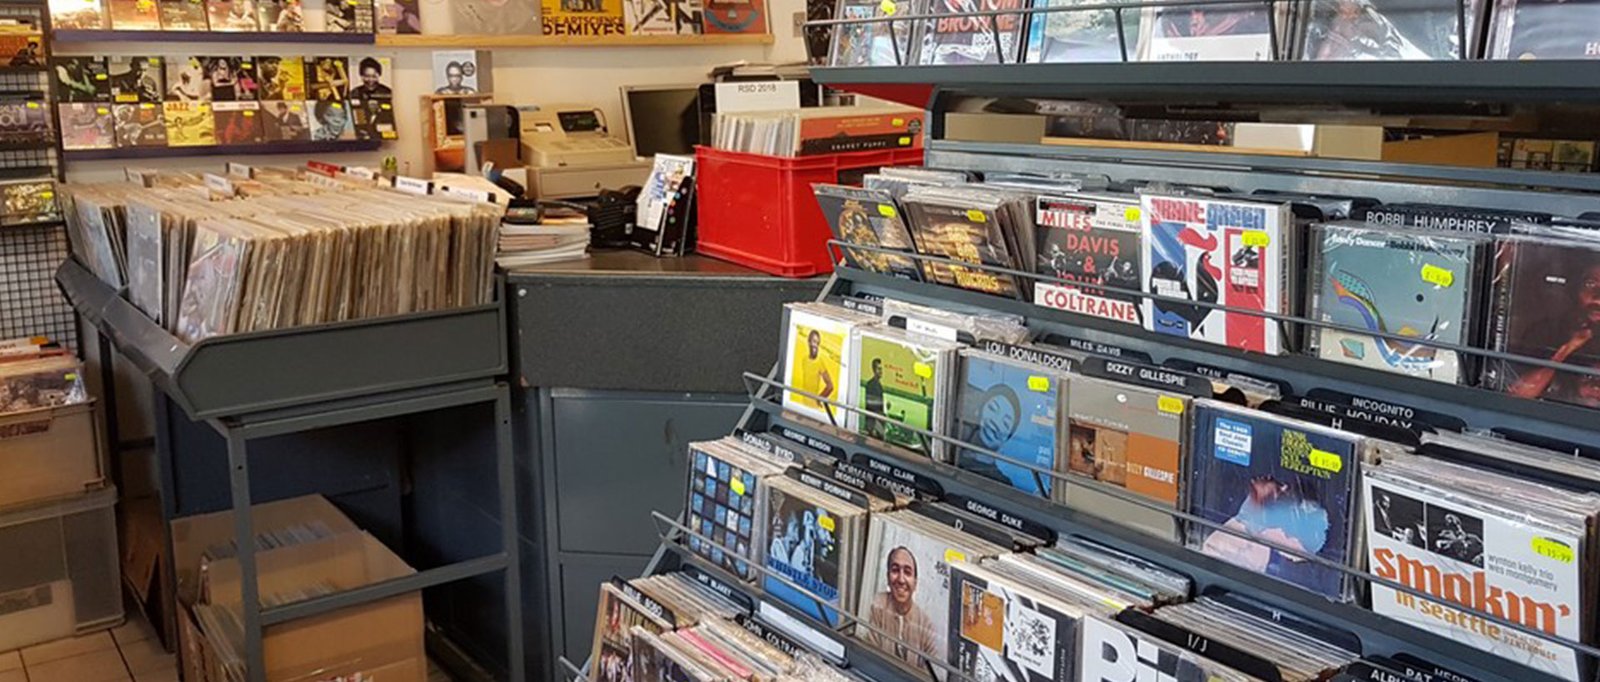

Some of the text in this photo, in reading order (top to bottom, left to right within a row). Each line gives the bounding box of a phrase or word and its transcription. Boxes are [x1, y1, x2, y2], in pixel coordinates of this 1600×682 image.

[738, 84, 776, 93] RSD 2018
[1041, 210, 1092, 233] MILES
[1366, 211, 1405, 226] BOBBI
[1414, 214, 1496, 234] HUMPHREY
[1067, 234, 1119, 256] DAVIS
[1083, 256, 1096, 272] &
[1044, 290, 1136, 321] COLTRANE
[985, 341, 1072, 374] LOU DONALDSON
[1069, 339, 1121, 357] MILES DAVIS
[1106, 362, 1187, 387] DIZZY GILLESPIE
[1352, 397, 1414, 419] INCOGNITO
[1331, 417, 1342, 430] H
[783, 429, 832, 453] GEORGE BENSON
[834, 470, 866, 489] DEODATO
[955, 519, 963, 532] D
[967, 500, 1023, 530] GEORGE DUKE
[813, 578, 838, 598] STOP
[1488, 564, 1557, 592] wes montgomery
[743, 618, 763, 636] JOHN
[1420, 600, 1501, 640] seattle
